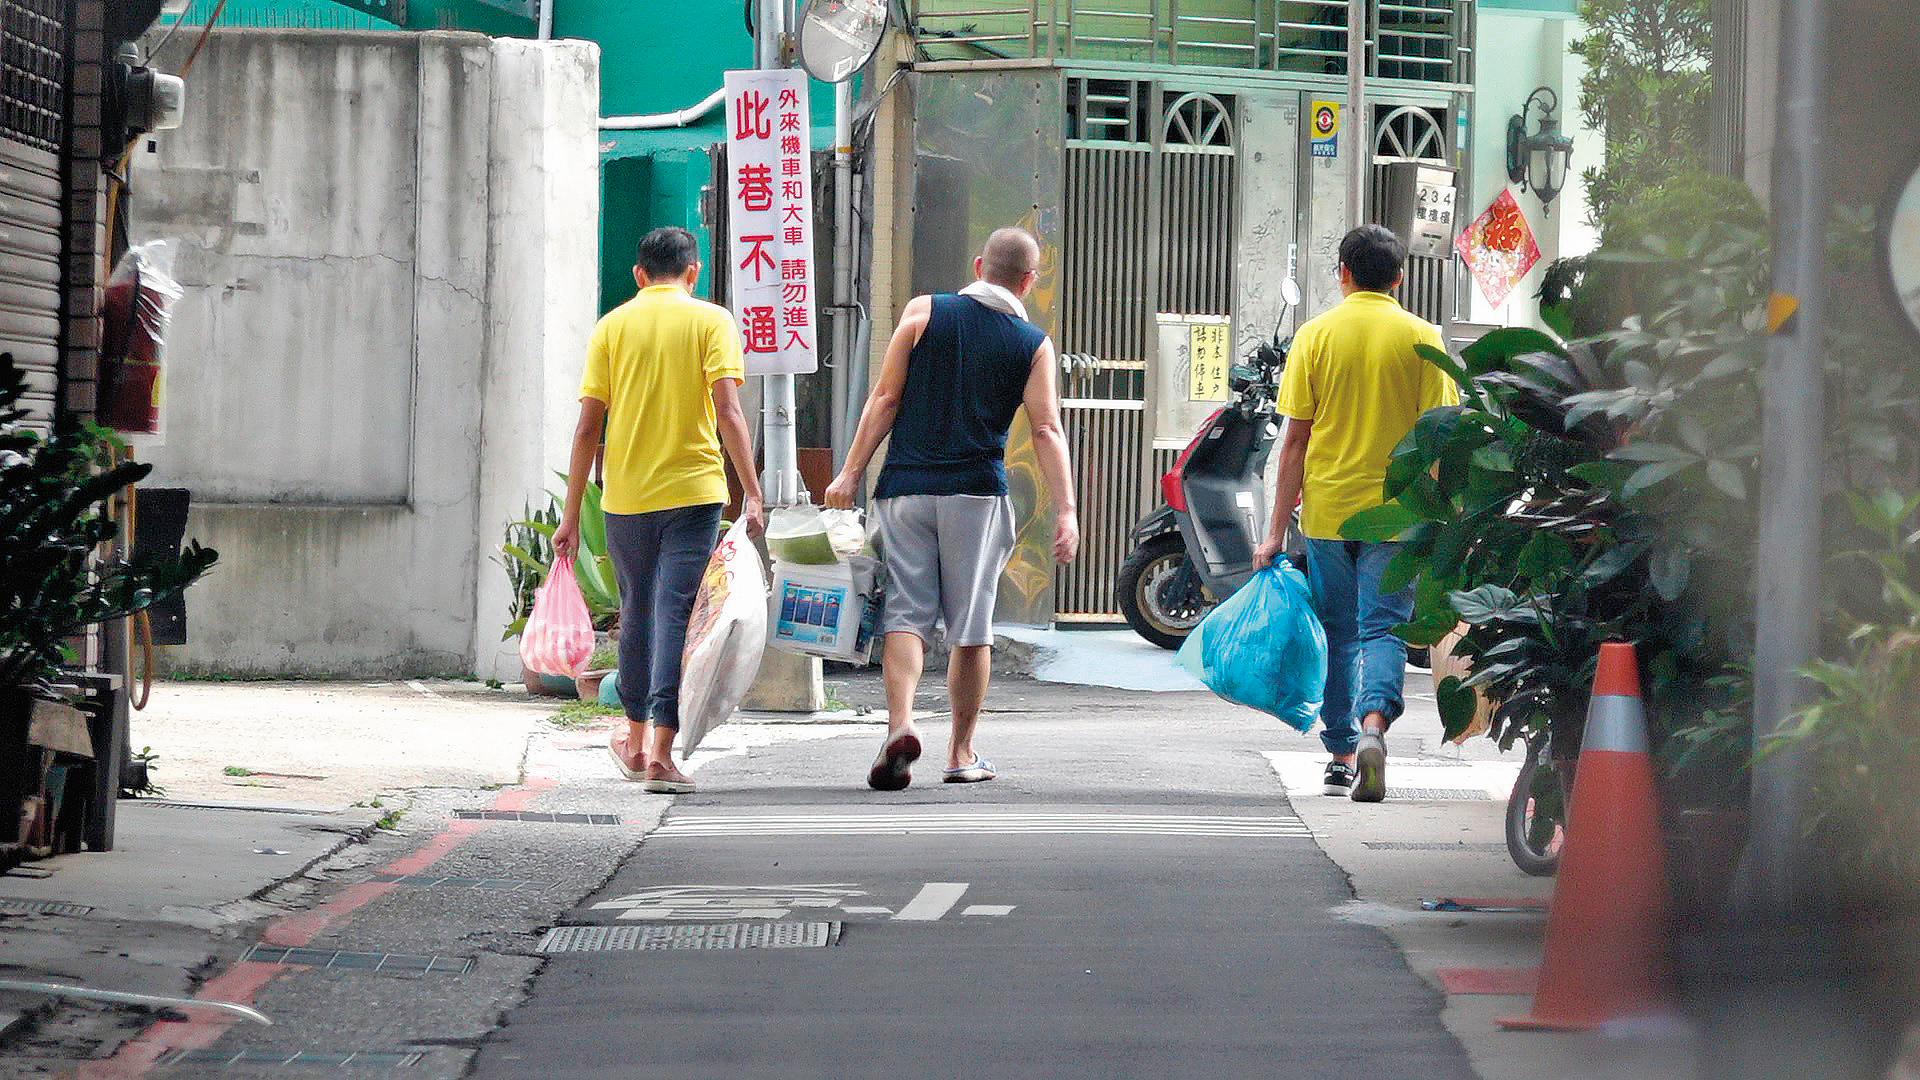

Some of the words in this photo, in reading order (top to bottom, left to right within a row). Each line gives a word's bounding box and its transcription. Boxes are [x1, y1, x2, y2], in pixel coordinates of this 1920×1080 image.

[736, 89, 778, 355] 此巷不通
[778, 89, 804, 246] 外來機車和大車
[1483, 205, 1522, 253] 福
[781, 258, 810, 352] 請勿進入
